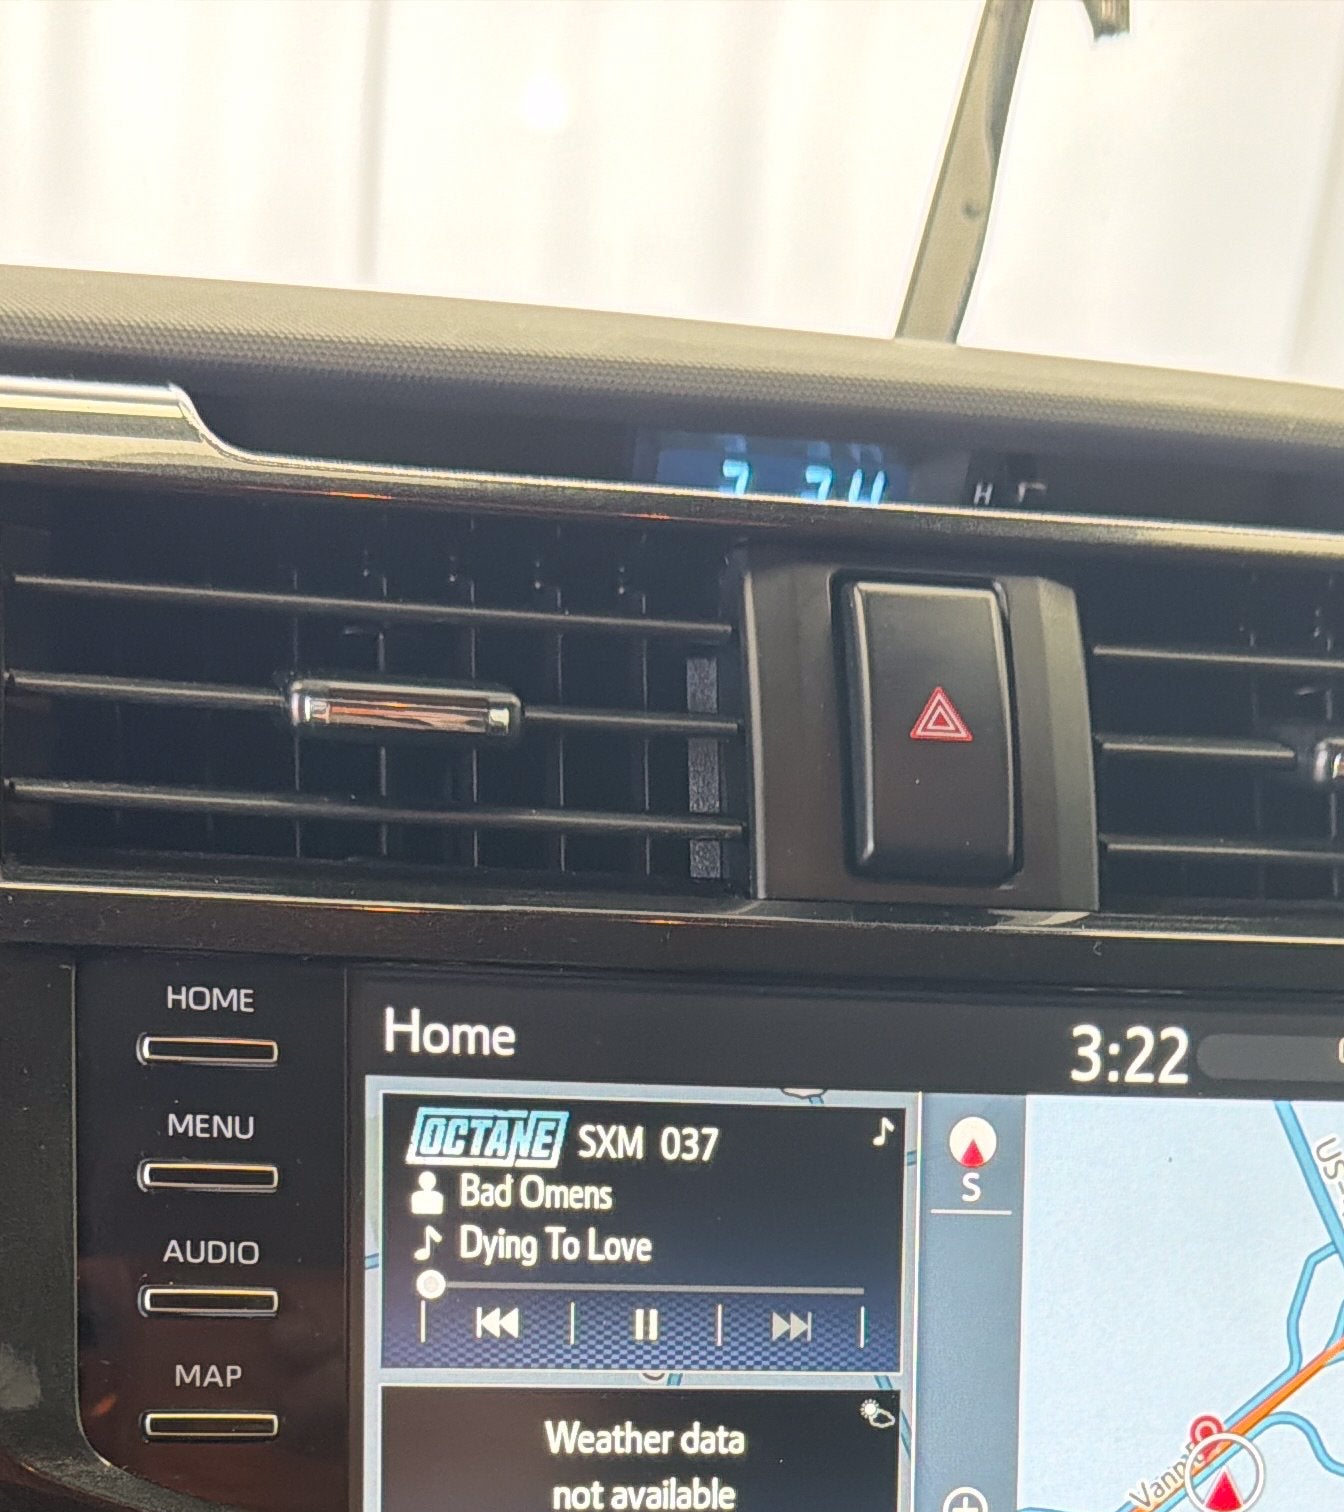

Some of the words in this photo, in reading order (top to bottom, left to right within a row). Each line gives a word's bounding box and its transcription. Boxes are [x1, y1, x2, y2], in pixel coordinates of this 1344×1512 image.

[167, 986, 254, 1012] HOME
[385, 1009, 516, 1056] Home
[1070, 1024, 1190, 1084] 3:22
[168, 1114, 255, 1140] MENU
[418, 1113, 561, 1162] OCTANE
[577, 1124, 644, 1159] SXM
[660, 1127, 719, 1161] 037
[459, 1172, 514, 1207] Bad
[519, 1174, 613, 1209] Omens
[961, 1171, 982, 1203] S
[163, 1240, 260, 1265] AUDIO
[459, 1224, 538, 1266] Dying
[545, 1226, 580, 1260] To
[587, 1227, 653, 1261] Love
[175, 1365, 242, 1387] MAP
[545, 1421, 674, 1454] Weather
[681, 1422, 745, 1454] data
[552, 1482, 604, 1511] not
[610, 1478, 736, 1511] available
